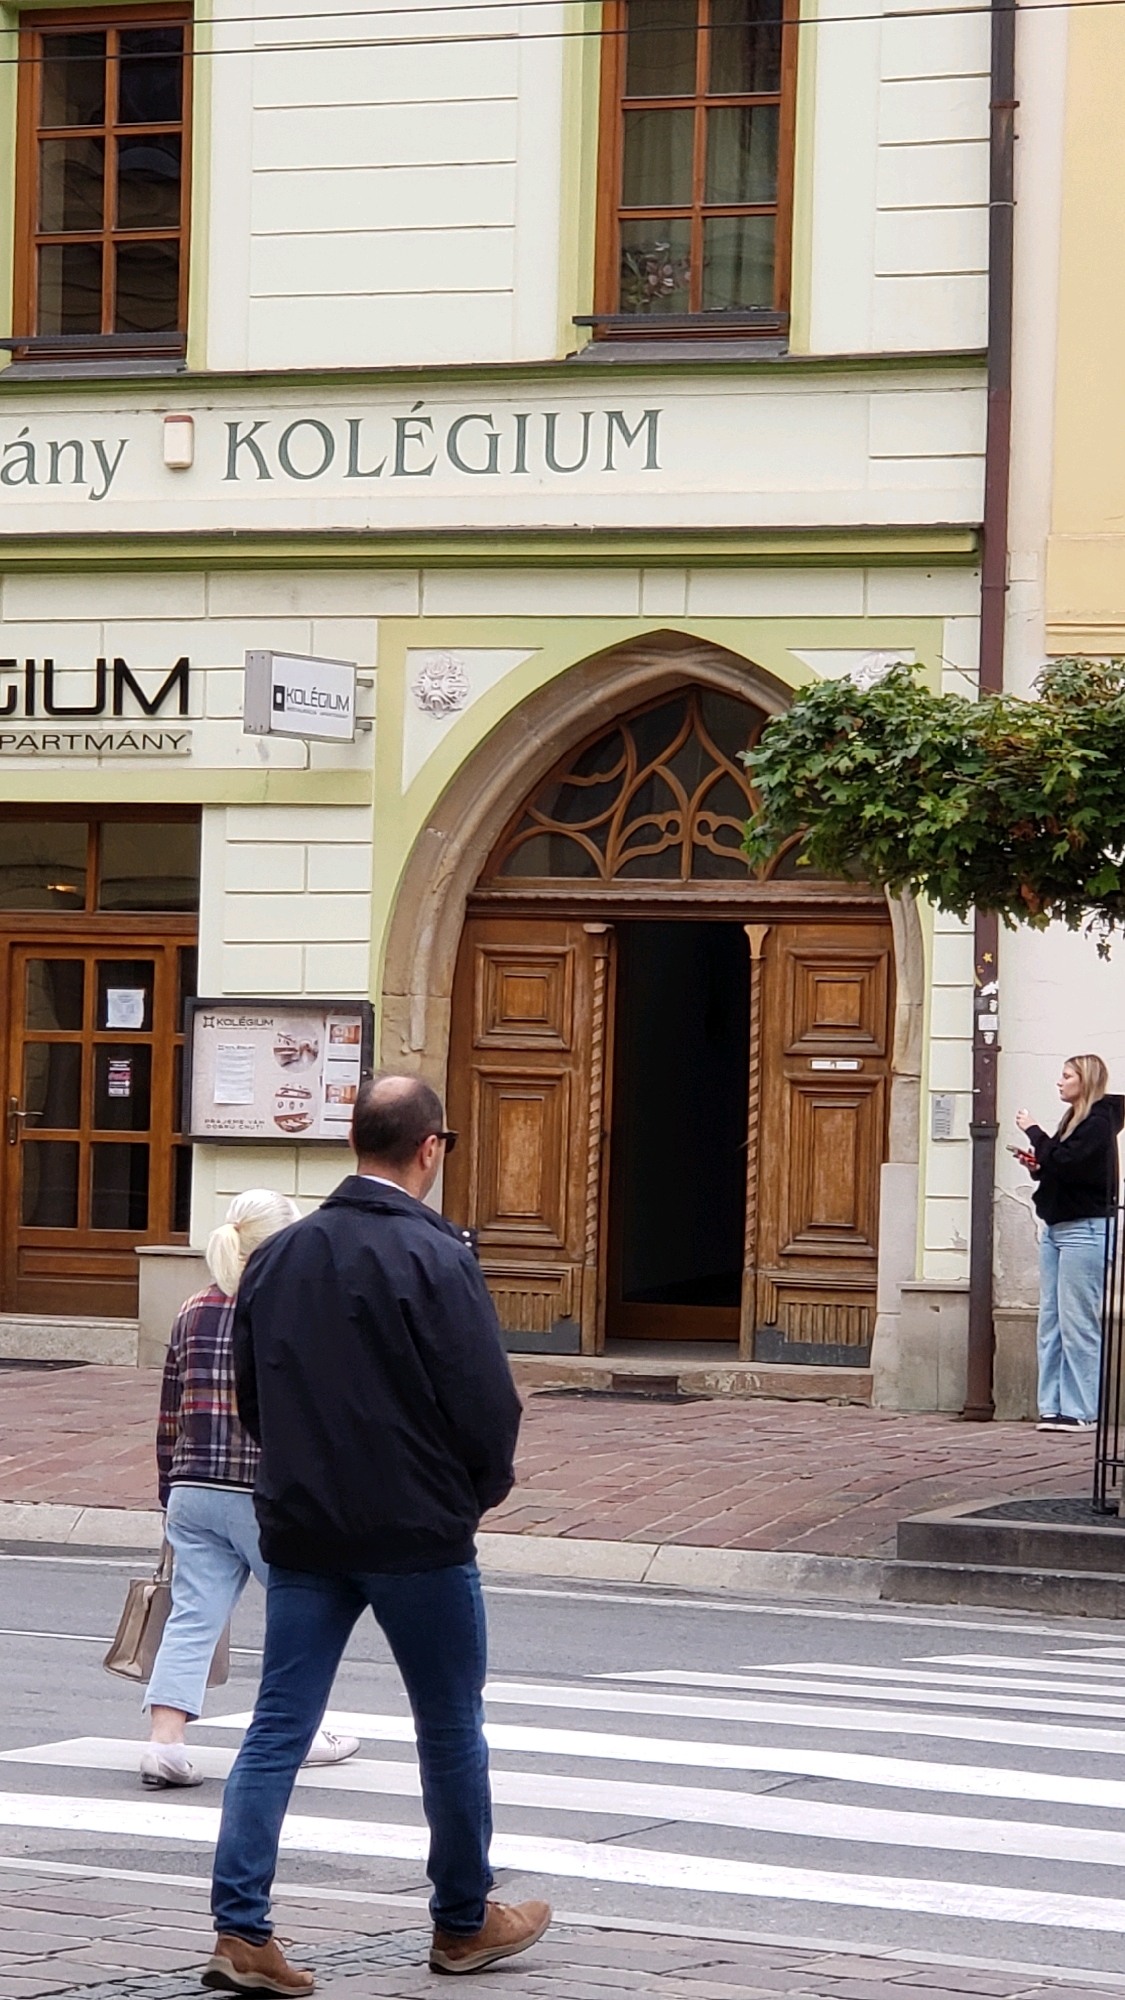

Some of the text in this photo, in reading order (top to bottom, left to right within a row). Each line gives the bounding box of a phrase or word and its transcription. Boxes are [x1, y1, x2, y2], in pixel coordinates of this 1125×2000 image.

[0, 400, 665, 501] ány KOLÉGIUM
[286, 686, 350, 712] KOLÉGIUM
[216, 1015, 274, 1027] KOLÉGIUM
